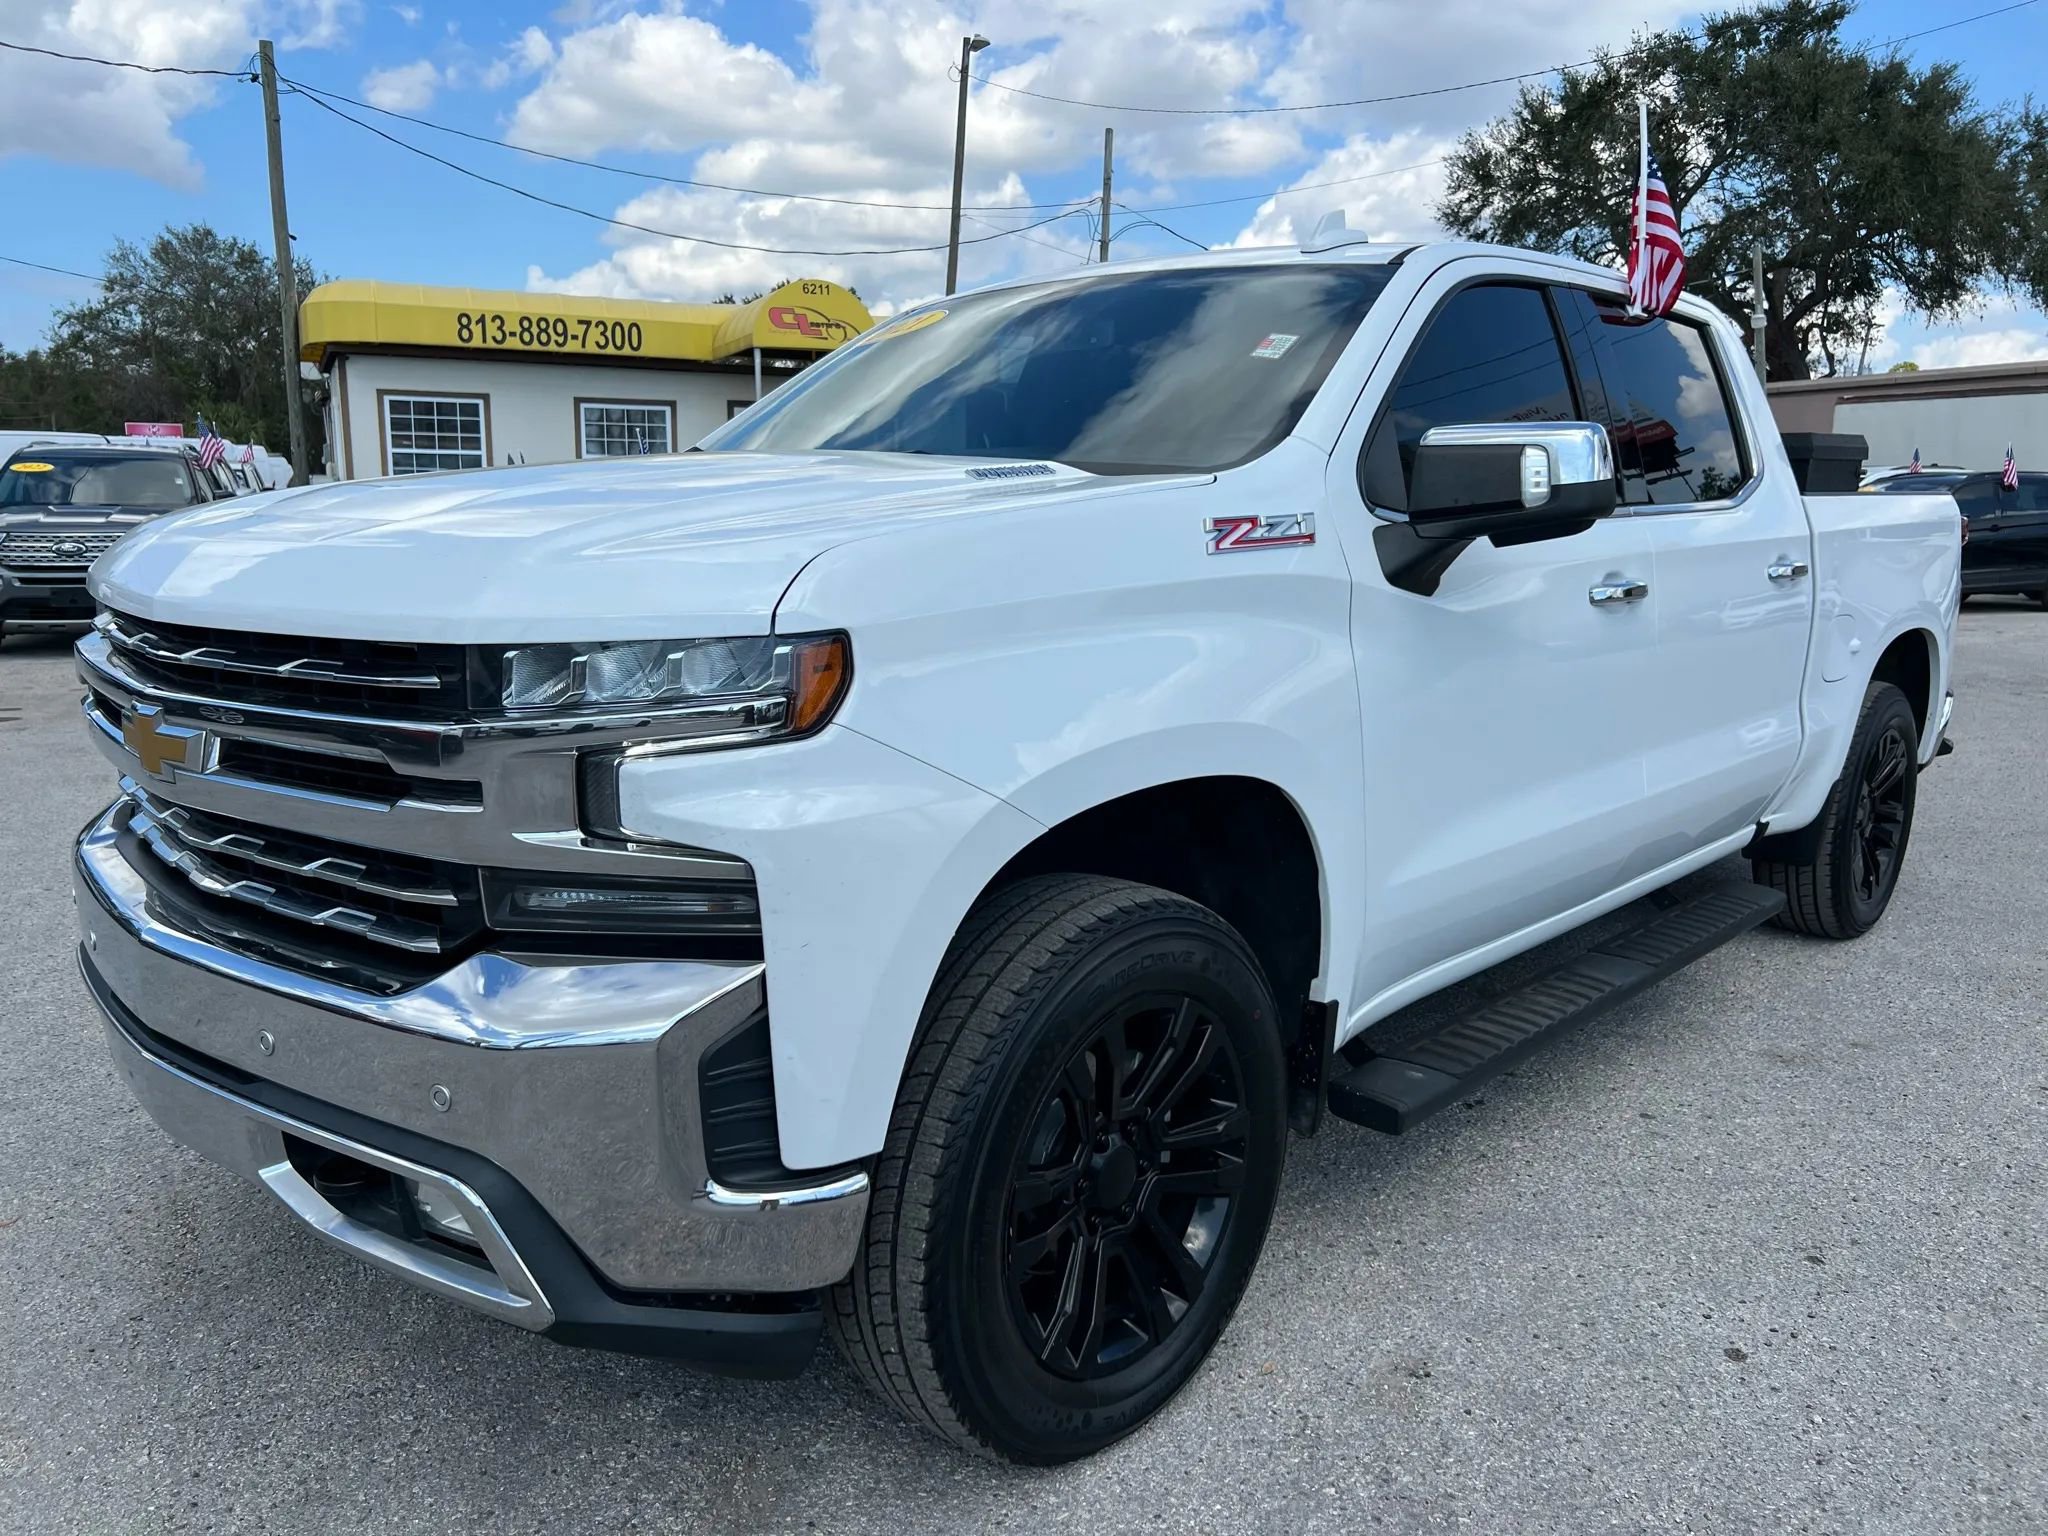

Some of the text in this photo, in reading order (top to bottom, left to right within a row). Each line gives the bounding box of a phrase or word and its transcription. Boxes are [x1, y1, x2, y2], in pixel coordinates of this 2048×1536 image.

[802, 283, 830, 296] 6211
[457, 312, 642, 351] 813-889-7300
[768, 307, 823, 336] CL
[1203, 512, 1316, 555] Z71
